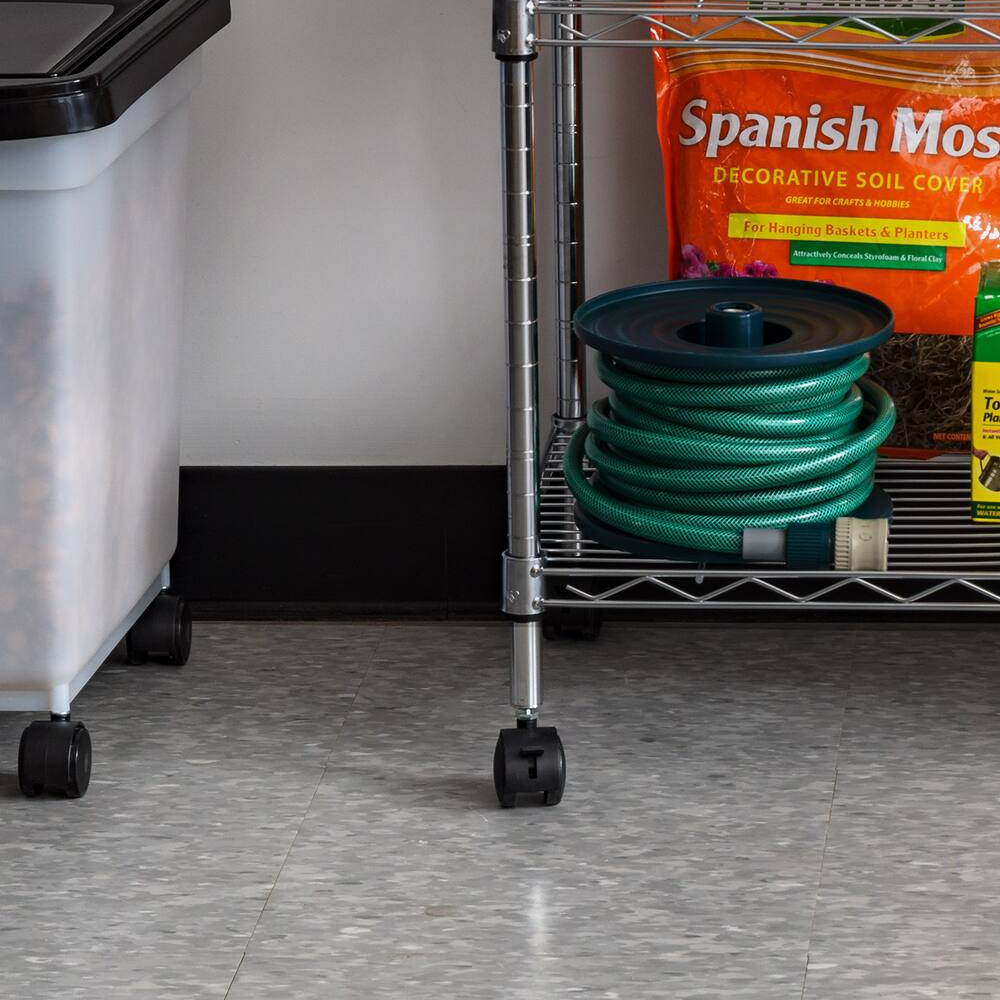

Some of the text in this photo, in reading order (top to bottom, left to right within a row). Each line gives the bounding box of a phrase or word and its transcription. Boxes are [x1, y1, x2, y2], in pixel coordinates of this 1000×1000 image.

[679, 99, 878, 159] Spanish
[713, 166, 984, 194] DECORATIVE SOIL COVER
[785, 195, 911, 209] GREAT FOR CRAFTS & HOBBIES
[744, 220, 950, 241] For Hanging Baskets & Planters
[792, 249, 943, 265] Attractively Conceals Styrofoam & Floral Clay
